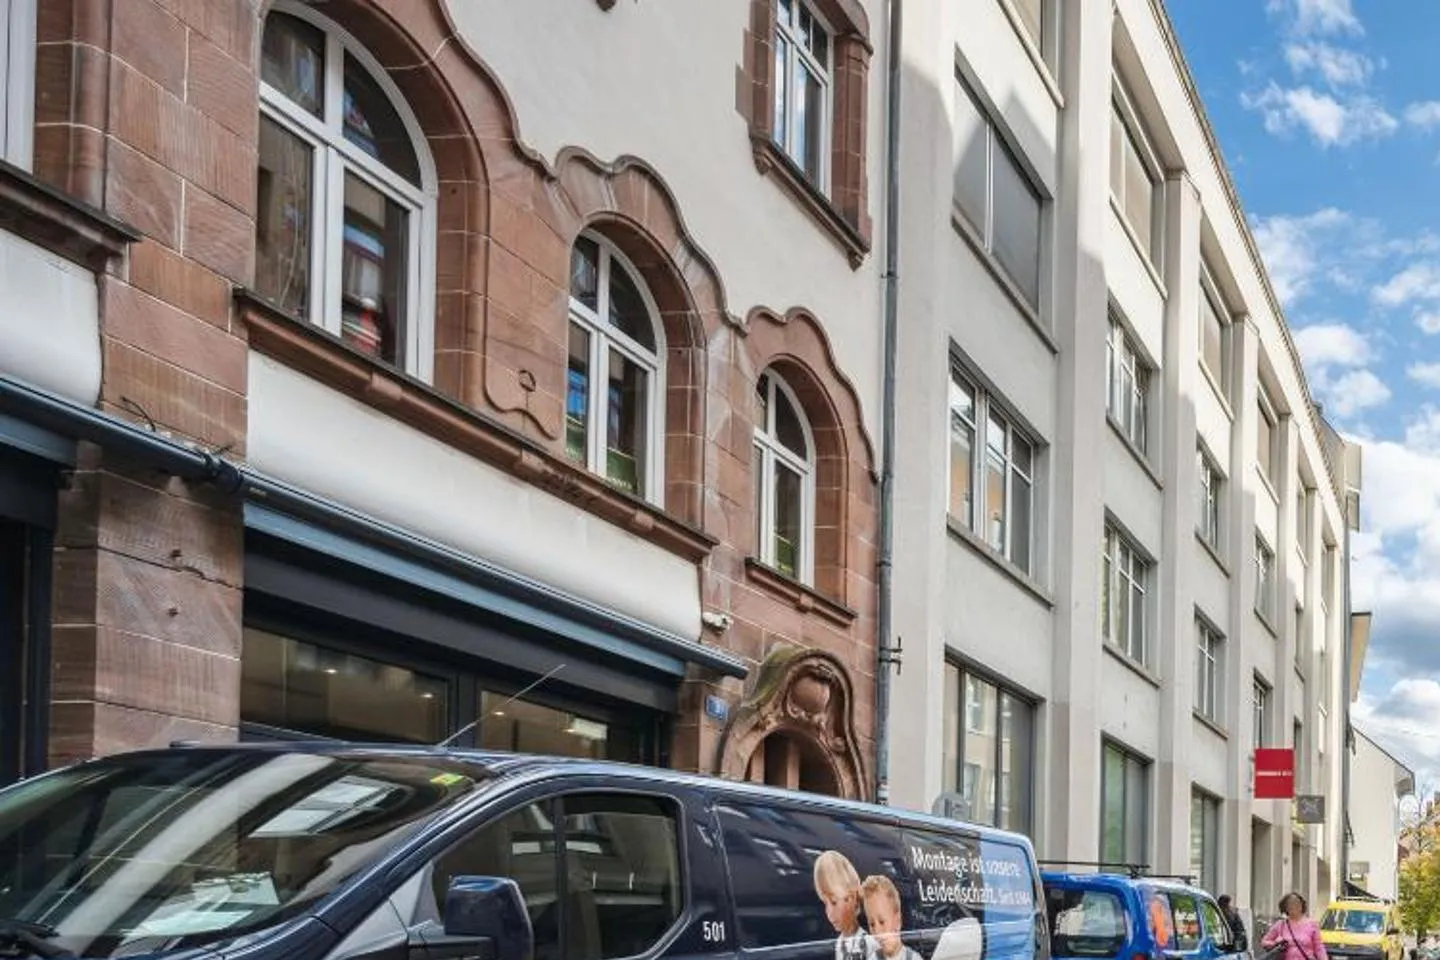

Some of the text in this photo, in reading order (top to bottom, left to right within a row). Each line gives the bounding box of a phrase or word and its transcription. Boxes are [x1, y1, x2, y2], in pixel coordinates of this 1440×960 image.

[911, 846, 968, 877] Montage
[969, 852, 985, 873] ist
[702, 920, 725, 941] 501
